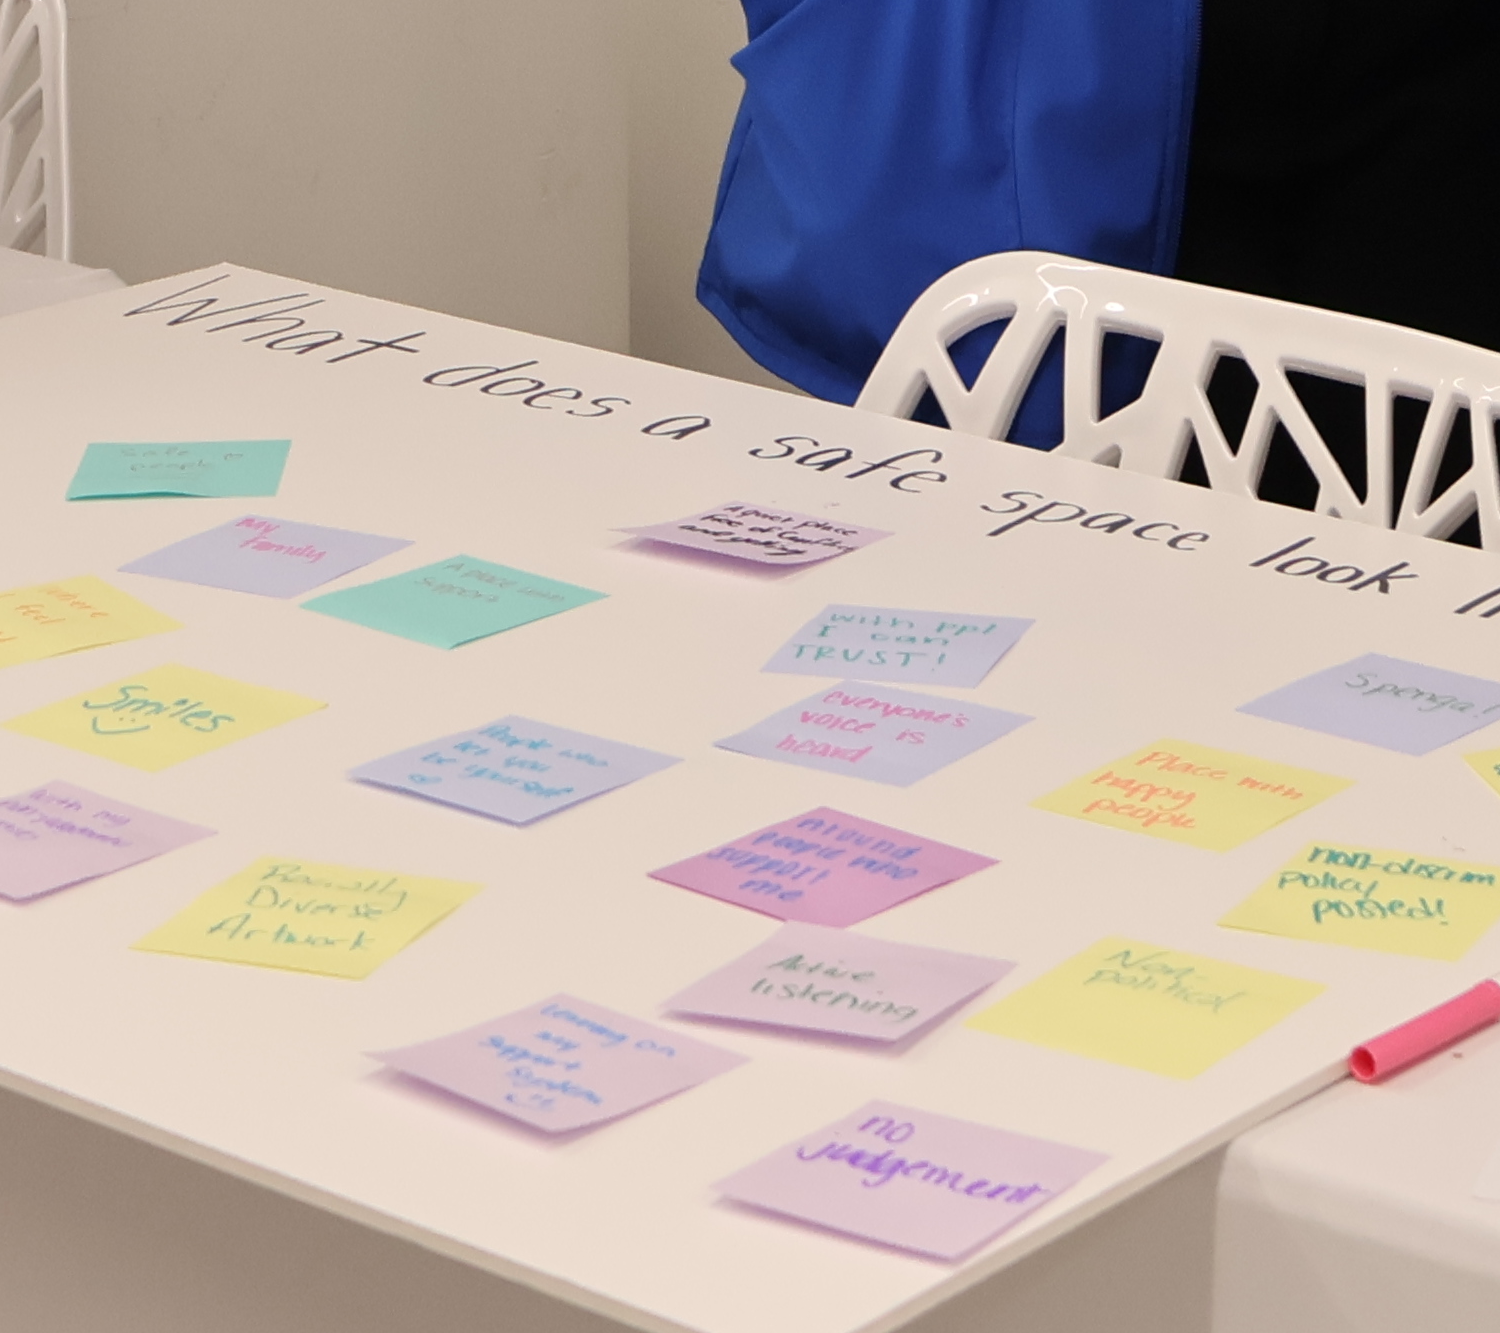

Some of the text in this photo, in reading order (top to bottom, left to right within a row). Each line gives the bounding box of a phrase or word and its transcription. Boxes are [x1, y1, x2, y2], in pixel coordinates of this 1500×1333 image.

[123, 274, 427, 364] What
[421, 359, 632, 421] does
[640, 412, 712, 441] a
[746, 435, 949, 495] safe
[978, 489, 1212, 554] space
[1248, 536, 1421, 596] look
[792, 642, 947, 672] TRUST!
[82, 684, 236, 734] Smiles
[799, 709, 927, 746] voice is
[822, 689, 971, 729] everyone's
[775, 733, 874, 764] heard
[1089, 770, 1198, 811] happy
[1135, 749, 1304, 801] Place with
[1081, 796, 1197, 830] people
[1276, 869, 1381, 900] policy
[1311, 896, 1451, 926] posted!
[857, 1115, 916, 1145] no
[796, 1141, 1053, 1204] judgement
